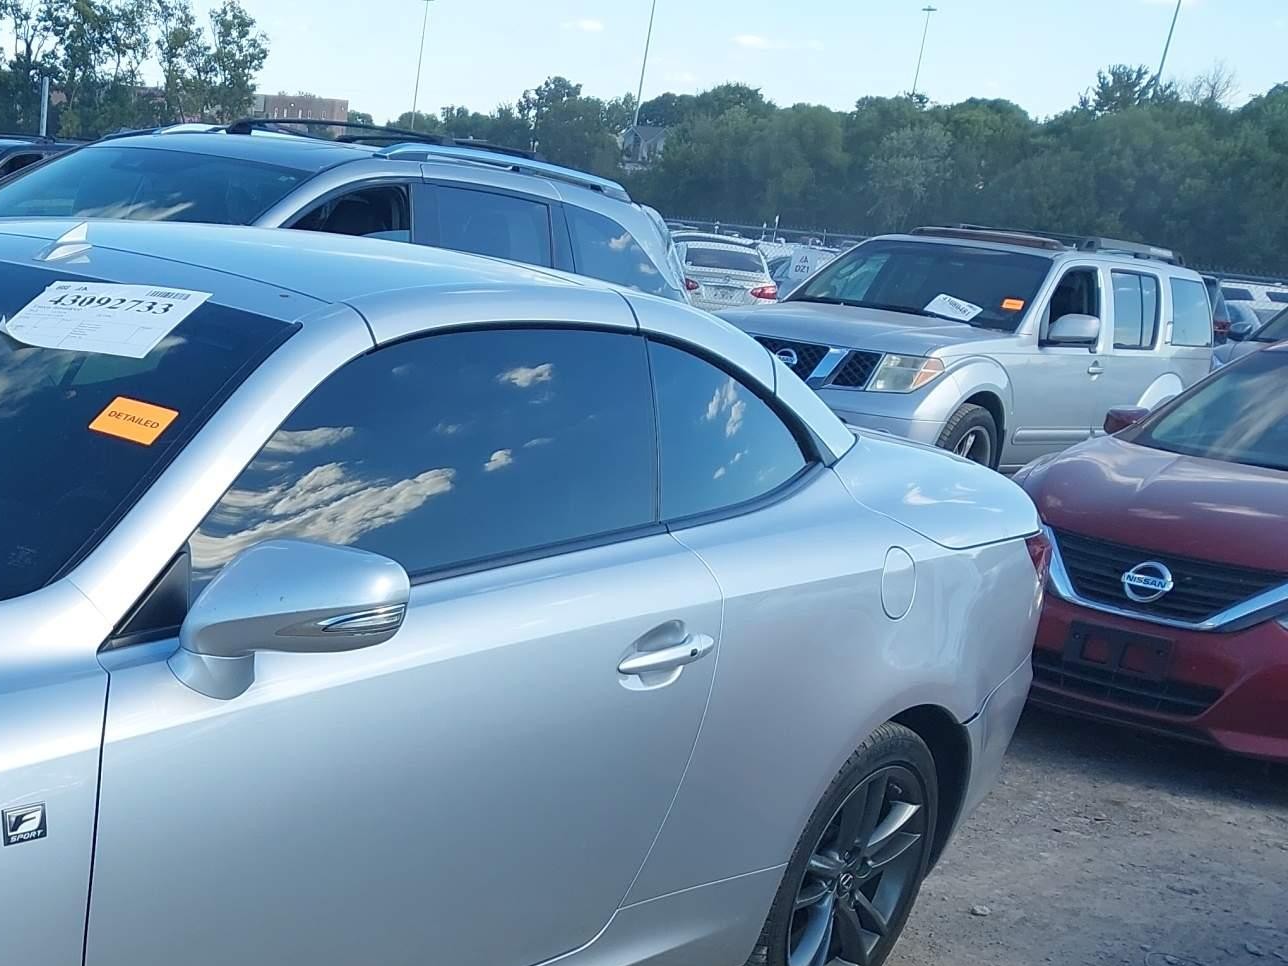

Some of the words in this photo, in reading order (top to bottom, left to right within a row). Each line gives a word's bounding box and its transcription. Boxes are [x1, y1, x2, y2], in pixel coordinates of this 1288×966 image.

[49, 294, 174, 314] 43092733
[107, 410, 160, 430] DETAILED
[1126, 574, 1167, 588] NISSAN
[10, 829, 44, 843] SPORT
